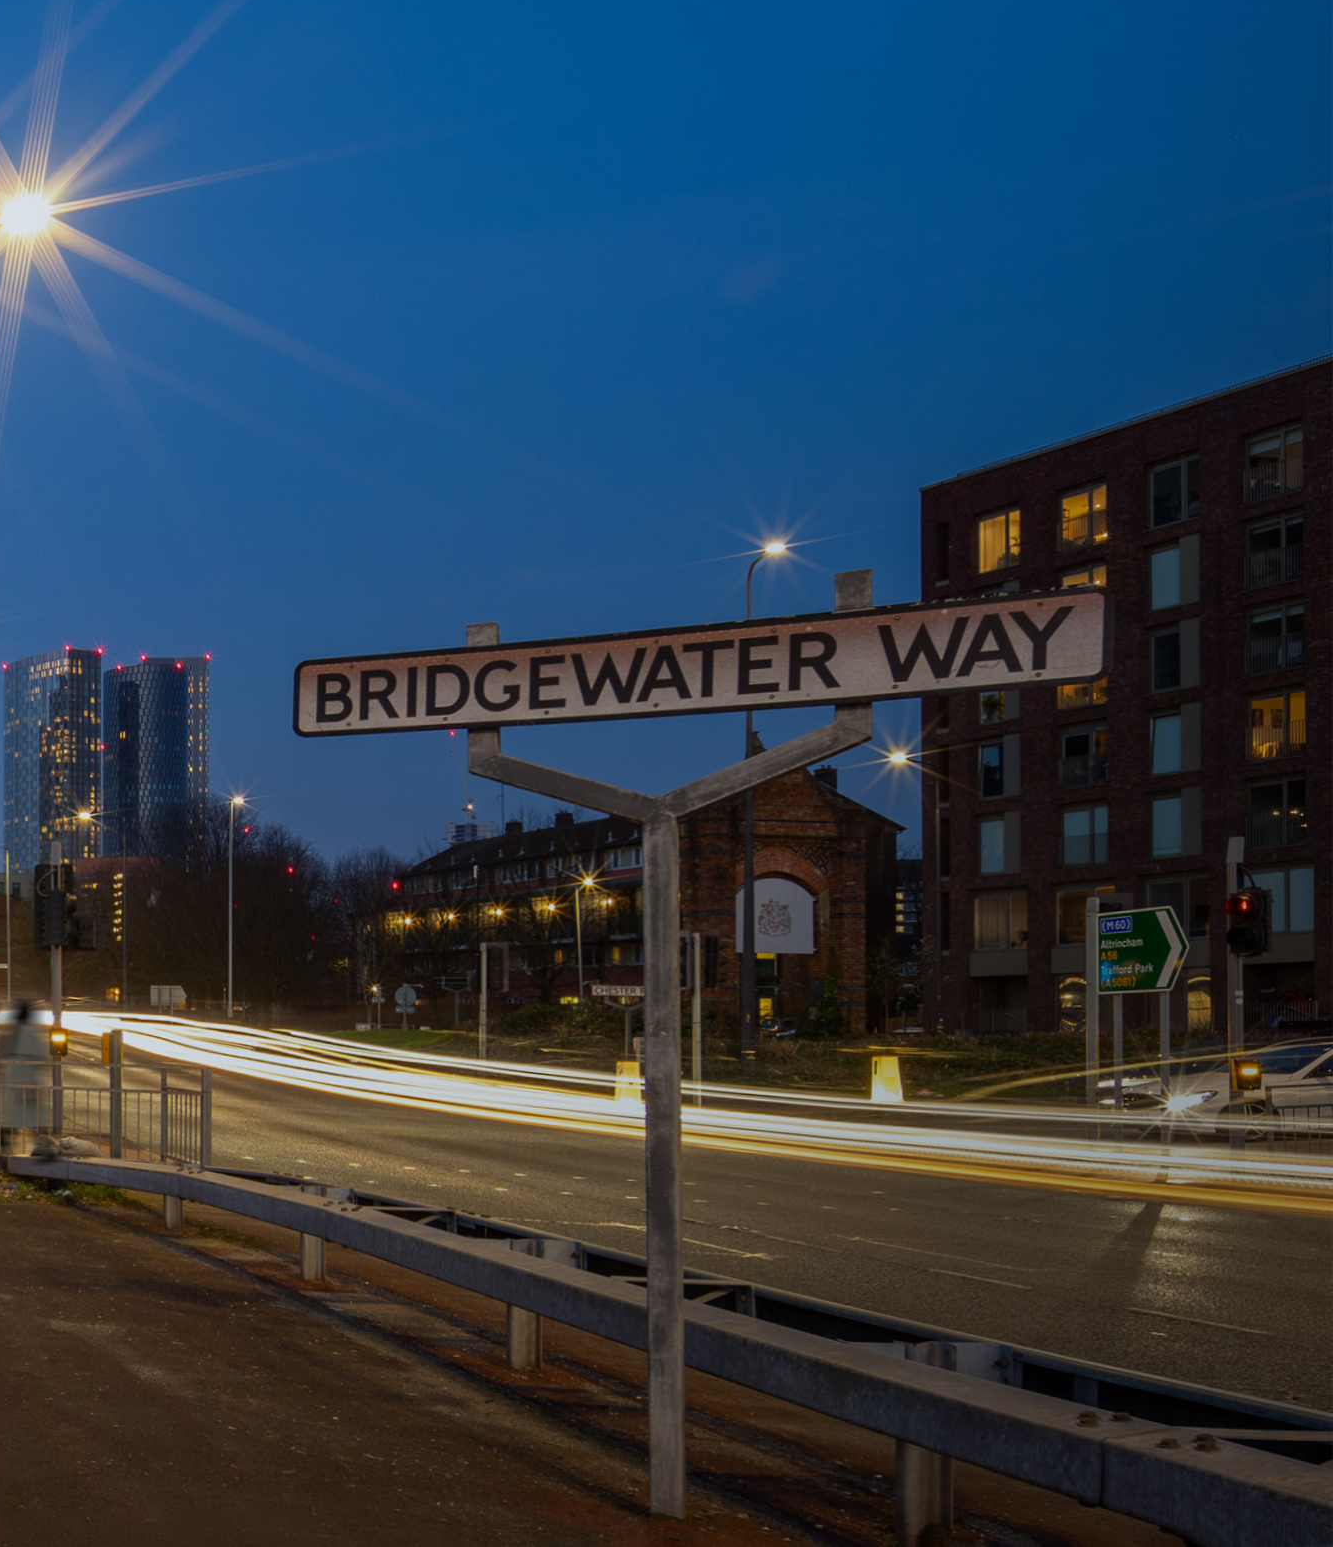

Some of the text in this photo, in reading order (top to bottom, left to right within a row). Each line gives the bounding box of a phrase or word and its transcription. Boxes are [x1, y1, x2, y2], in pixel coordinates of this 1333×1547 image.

[315, 605, 1075, 725] BRIDGEWATER WAY
[1100, 938, 1144, 949] Altrincham
[1100, 963, 1154, 975] Trafford Park
[594, 986, 637, 995] CHESTER
